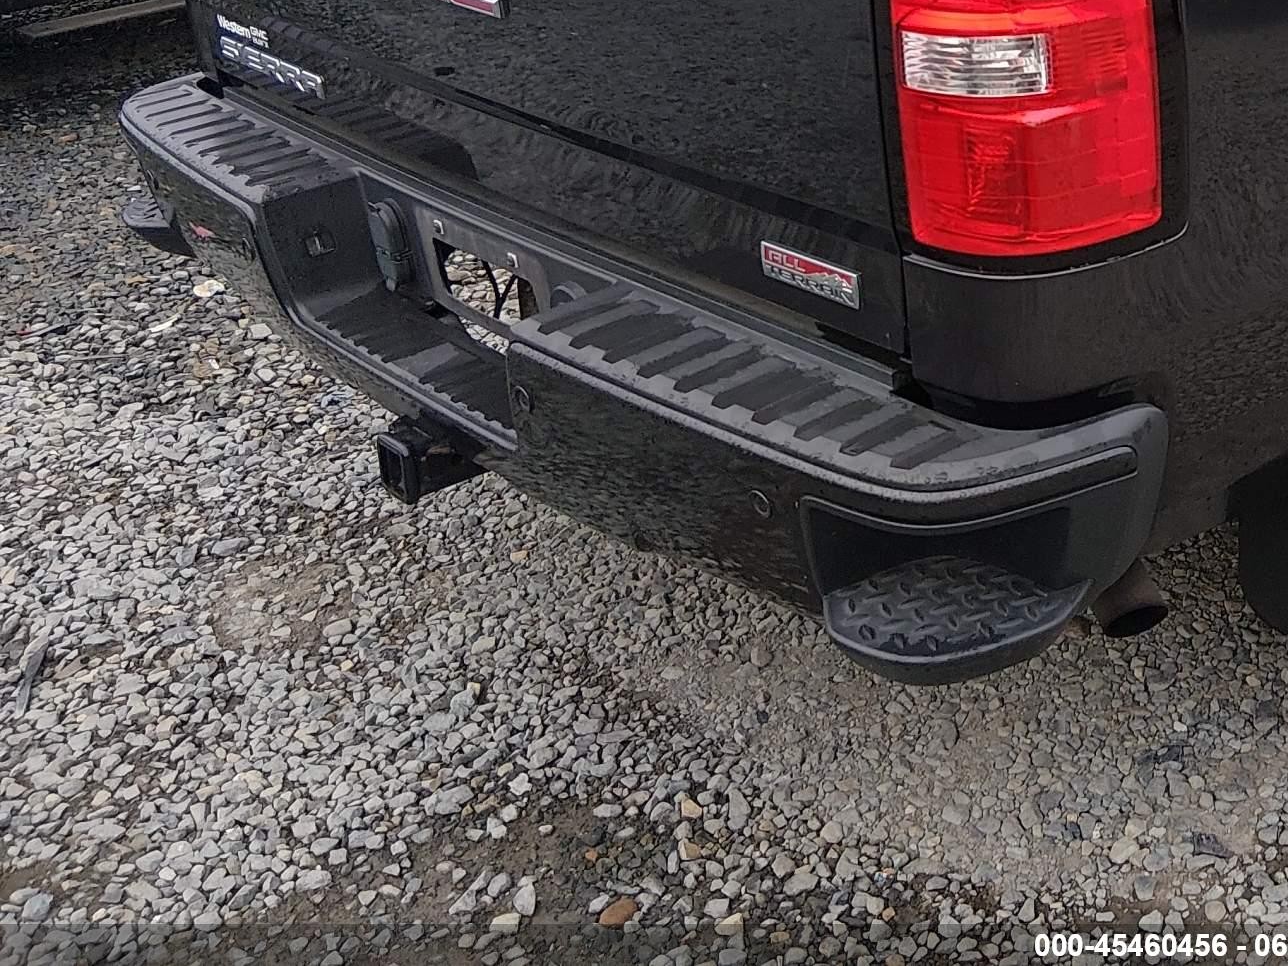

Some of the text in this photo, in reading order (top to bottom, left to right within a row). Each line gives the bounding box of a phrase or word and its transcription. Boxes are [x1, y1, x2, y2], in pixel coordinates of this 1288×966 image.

[217, 14, 251, 38] Western
[220, 35, 326, 100] SIERRA
[767, 249, 806, 273] ALL
